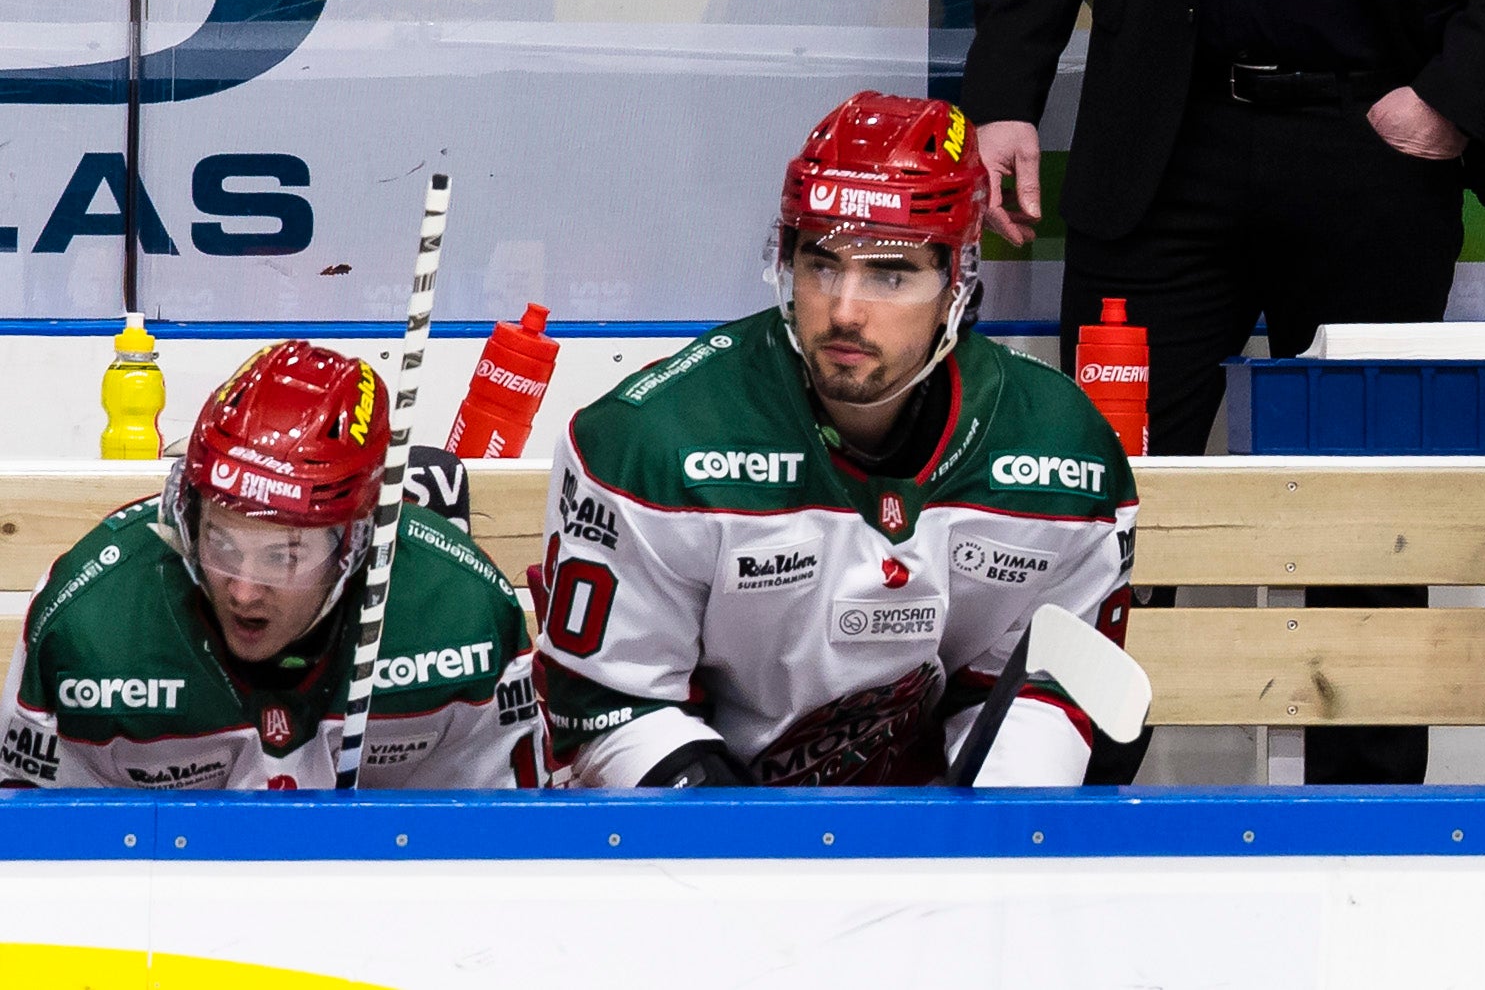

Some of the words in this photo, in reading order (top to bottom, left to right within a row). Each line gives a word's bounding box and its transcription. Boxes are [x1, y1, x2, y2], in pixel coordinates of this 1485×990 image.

[943, 104, 967, 162] Malu
[0, 152, 314, 257] AS
[839, 200, 871, 218] SPEL
[840, 188, 902, 209] SVENSKA
[684, 451, 804, 483] coreIT
[992, 455, 1106, 493] coreIT
[239, 484, 271, 505] SPEL
[242, 471, 303, 499] SVENSKA
[992, 551, 1048, 572] VIMAB
[737, 570, 815, 590] SURSTRÖMMING
[986, 566, 1028, 584] BESS
[872, 607, 936, 622] SYNSAM
[870, 620, 934, 635] SPORTS
[373, 641, 494, 689] coreIT
[58, 678, 186, 709] coreIT
[582, 707, 633, 731] NORR
[370, 741, 429, 756] VIMAB
[761, 717, 876, 783] MOD
[366, 753, 409, 766] BESS
